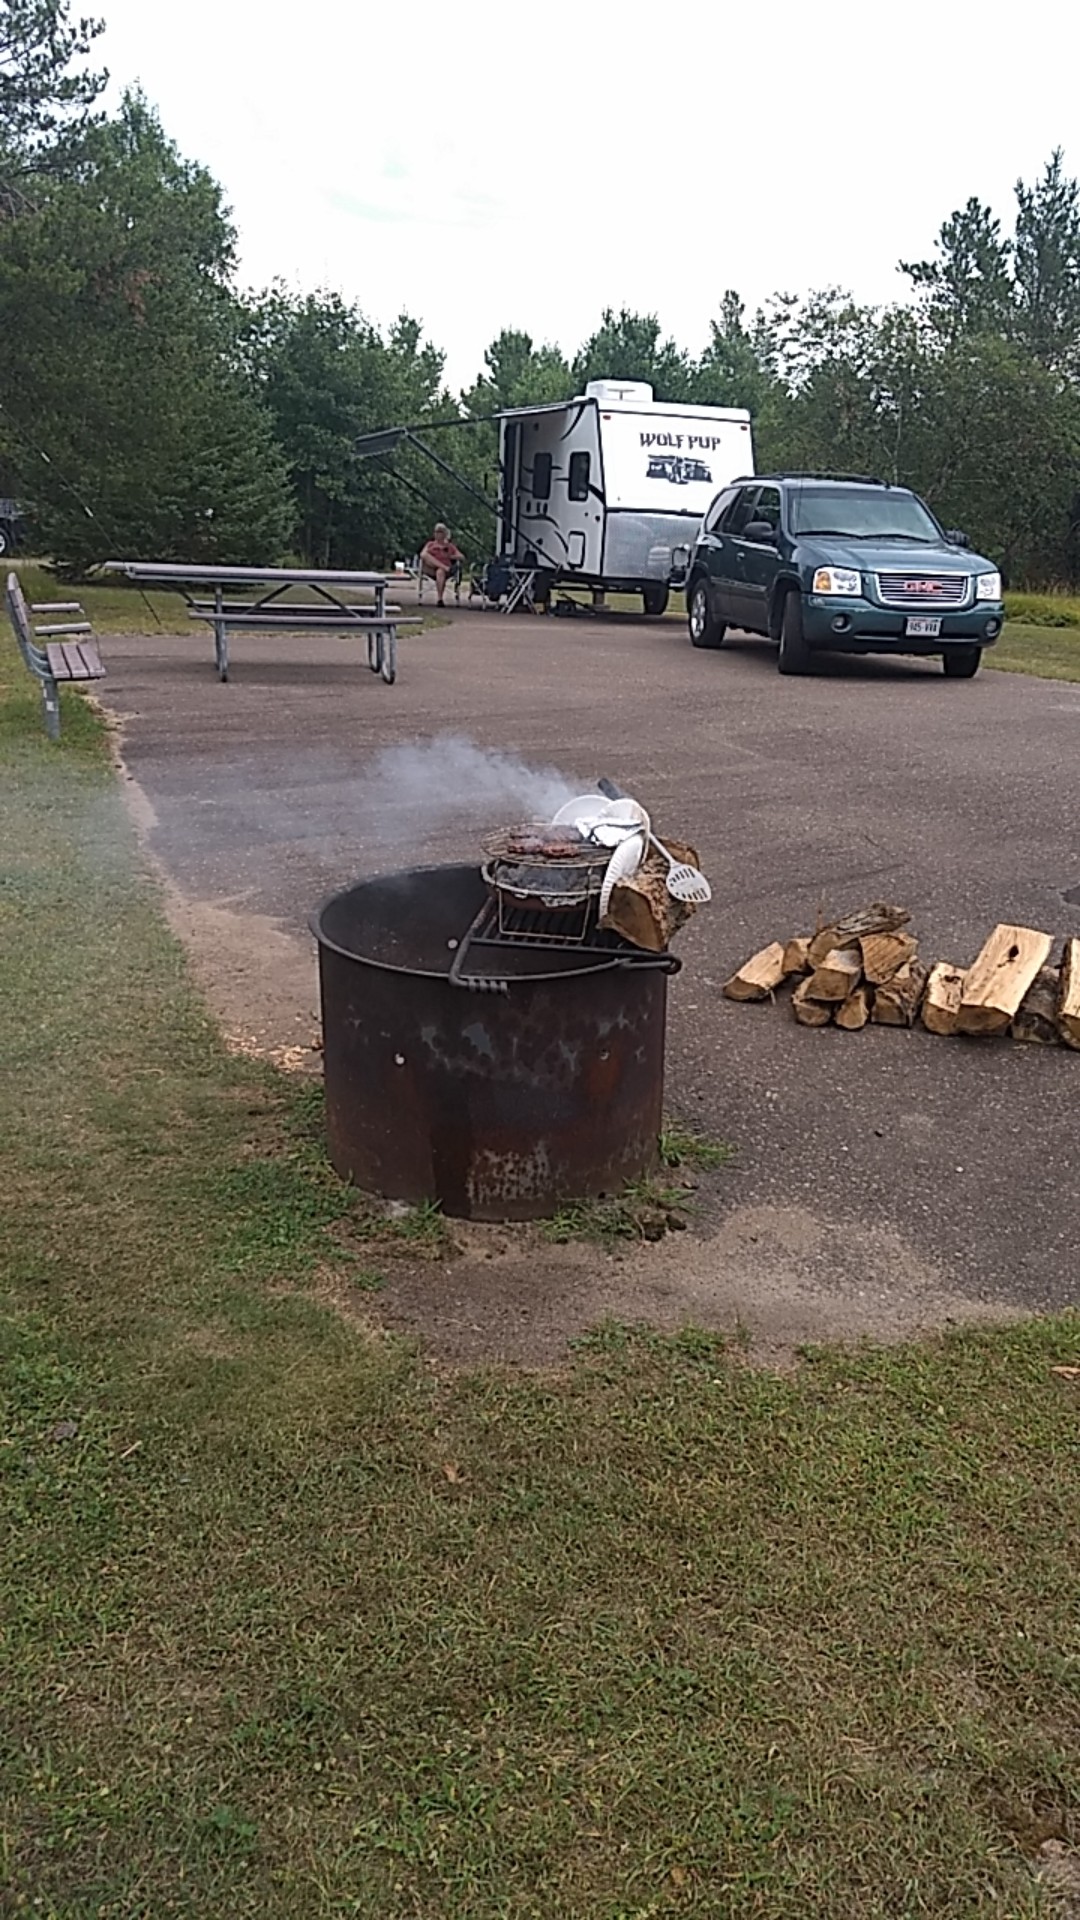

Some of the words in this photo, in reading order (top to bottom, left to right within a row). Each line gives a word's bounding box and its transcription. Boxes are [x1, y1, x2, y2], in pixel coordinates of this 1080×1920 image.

[639, 432, 685, 449] WOLF
[687, 435, 721, 451] PUP
[903, 580, 943, 594] GMC
